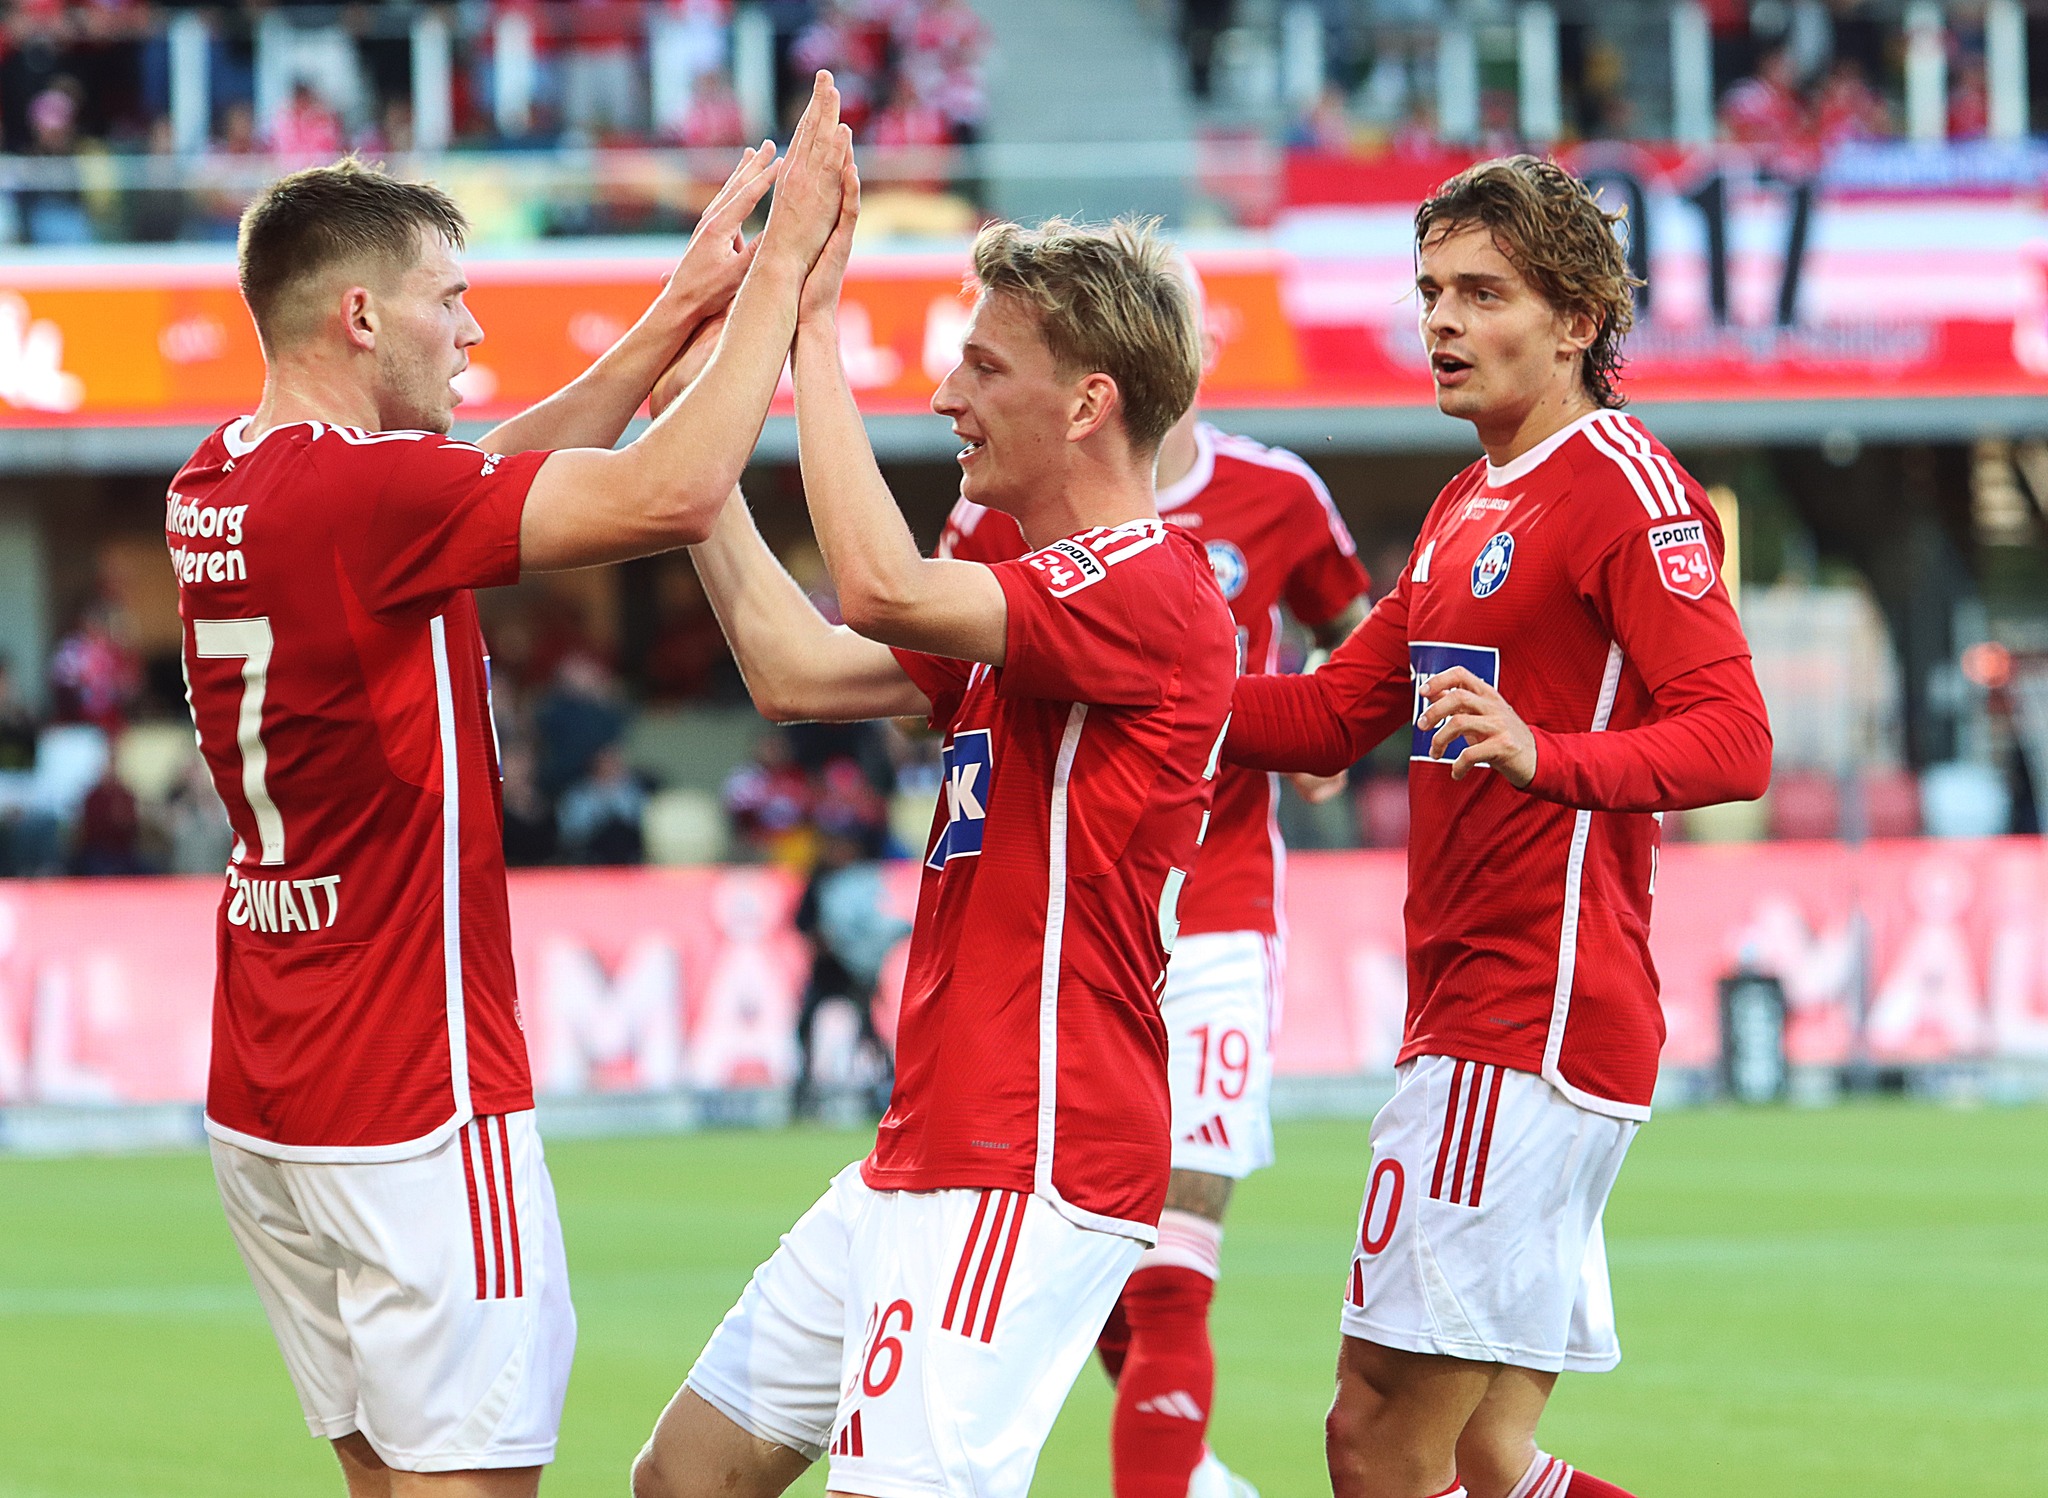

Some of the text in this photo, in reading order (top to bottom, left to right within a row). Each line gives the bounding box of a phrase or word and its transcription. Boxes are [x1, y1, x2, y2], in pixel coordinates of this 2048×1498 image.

[1652, 526, 1700, 547] SPORT
[1029, 554, 1075, 587] 24
[1052, 543, 1100, 575] SPORT
[1667, 552, 1708, 583] 24
[1187, 1025, 1249, 1099] 19
